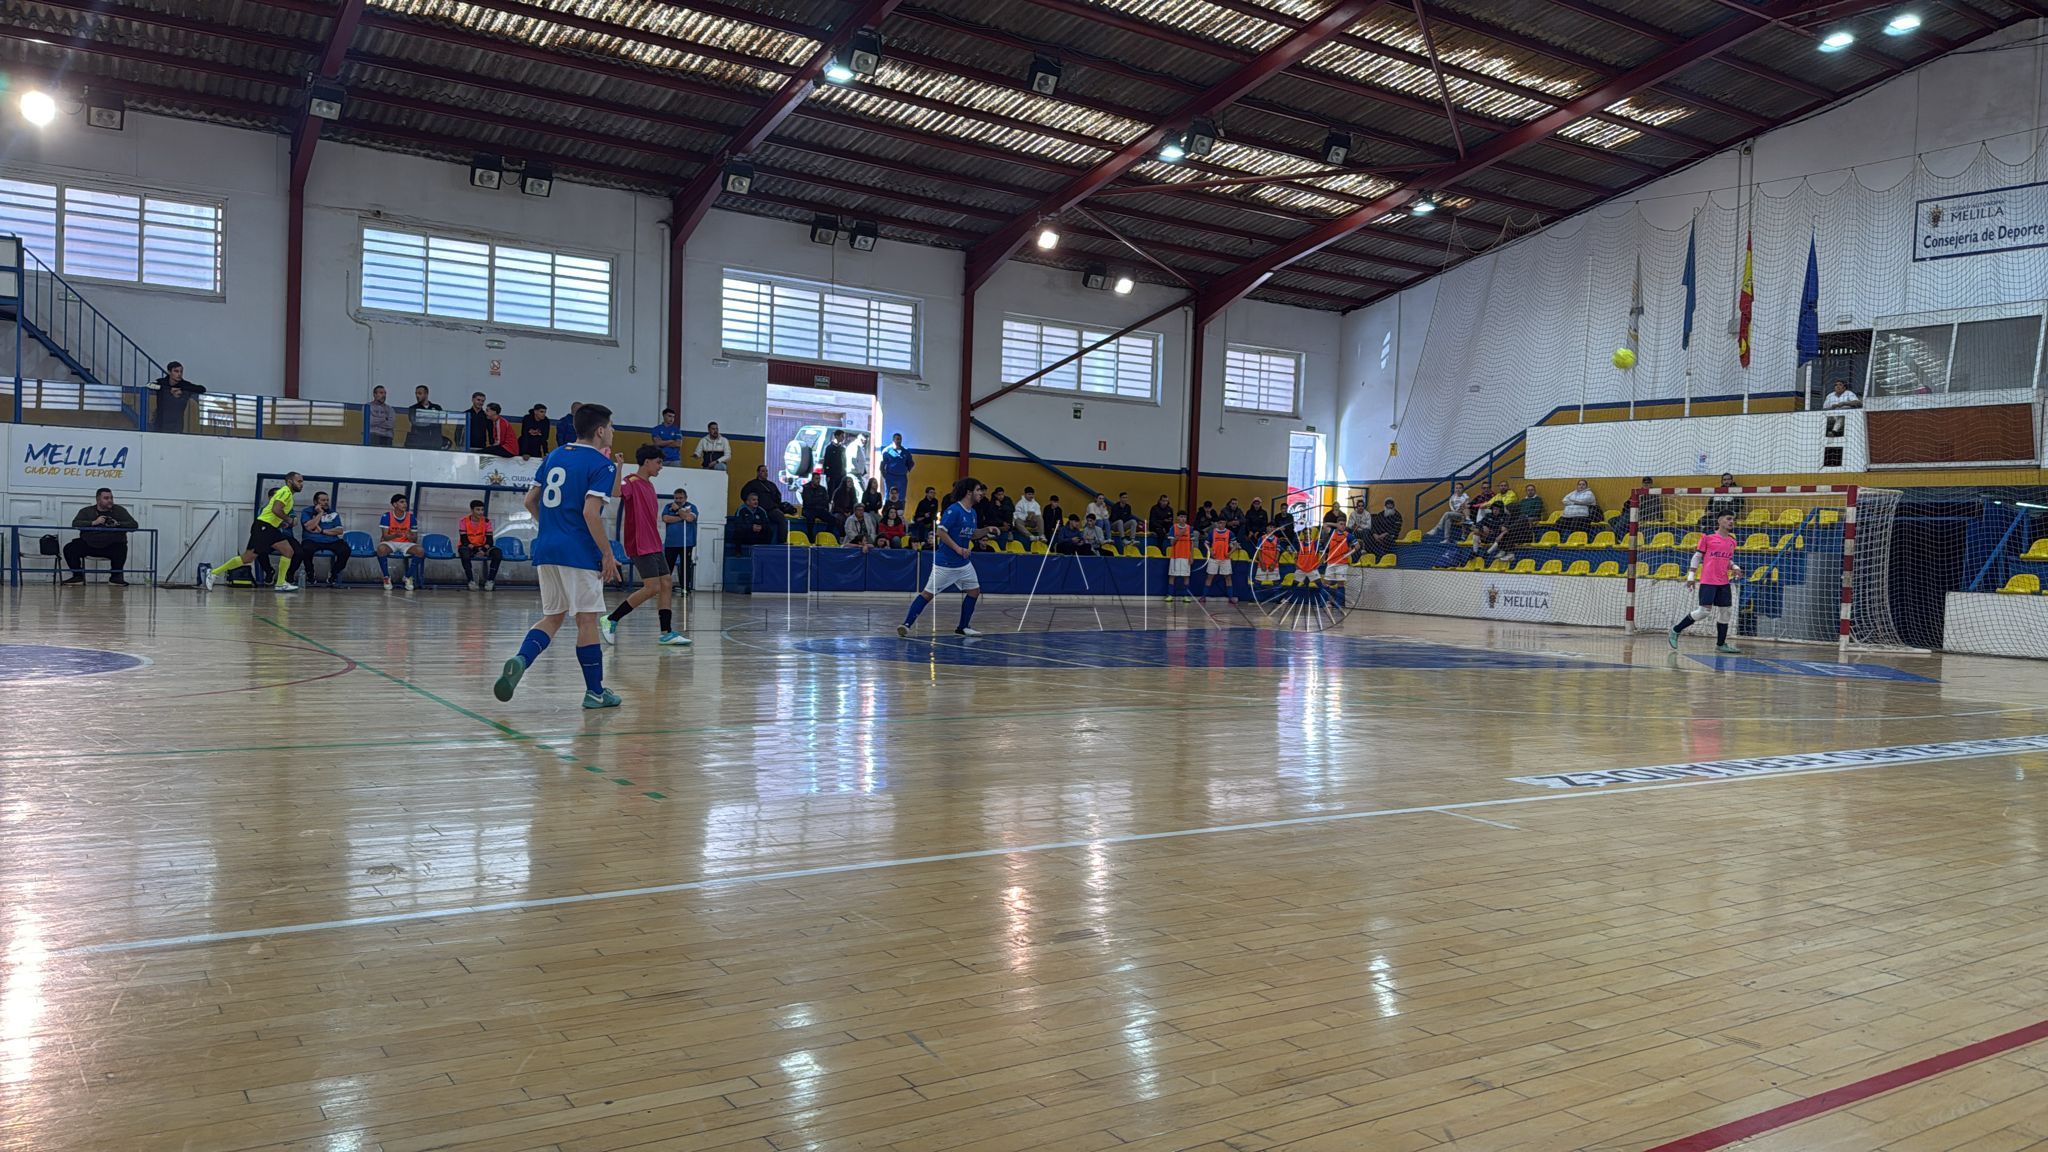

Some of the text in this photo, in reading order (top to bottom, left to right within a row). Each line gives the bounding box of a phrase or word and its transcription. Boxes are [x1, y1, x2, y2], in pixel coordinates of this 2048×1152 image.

[1950, 206, 2005, 222] MELILLA
[1923, 223, 2045, 249] Consejería de Deporte
[24, 442, 129, 469] MELILLA
[24, 465, 123, 479] CIUDAD DEL DEPORTE
[542, 466, 566, 508] 8
[1504, 596, 1548, 608] MELILLA
